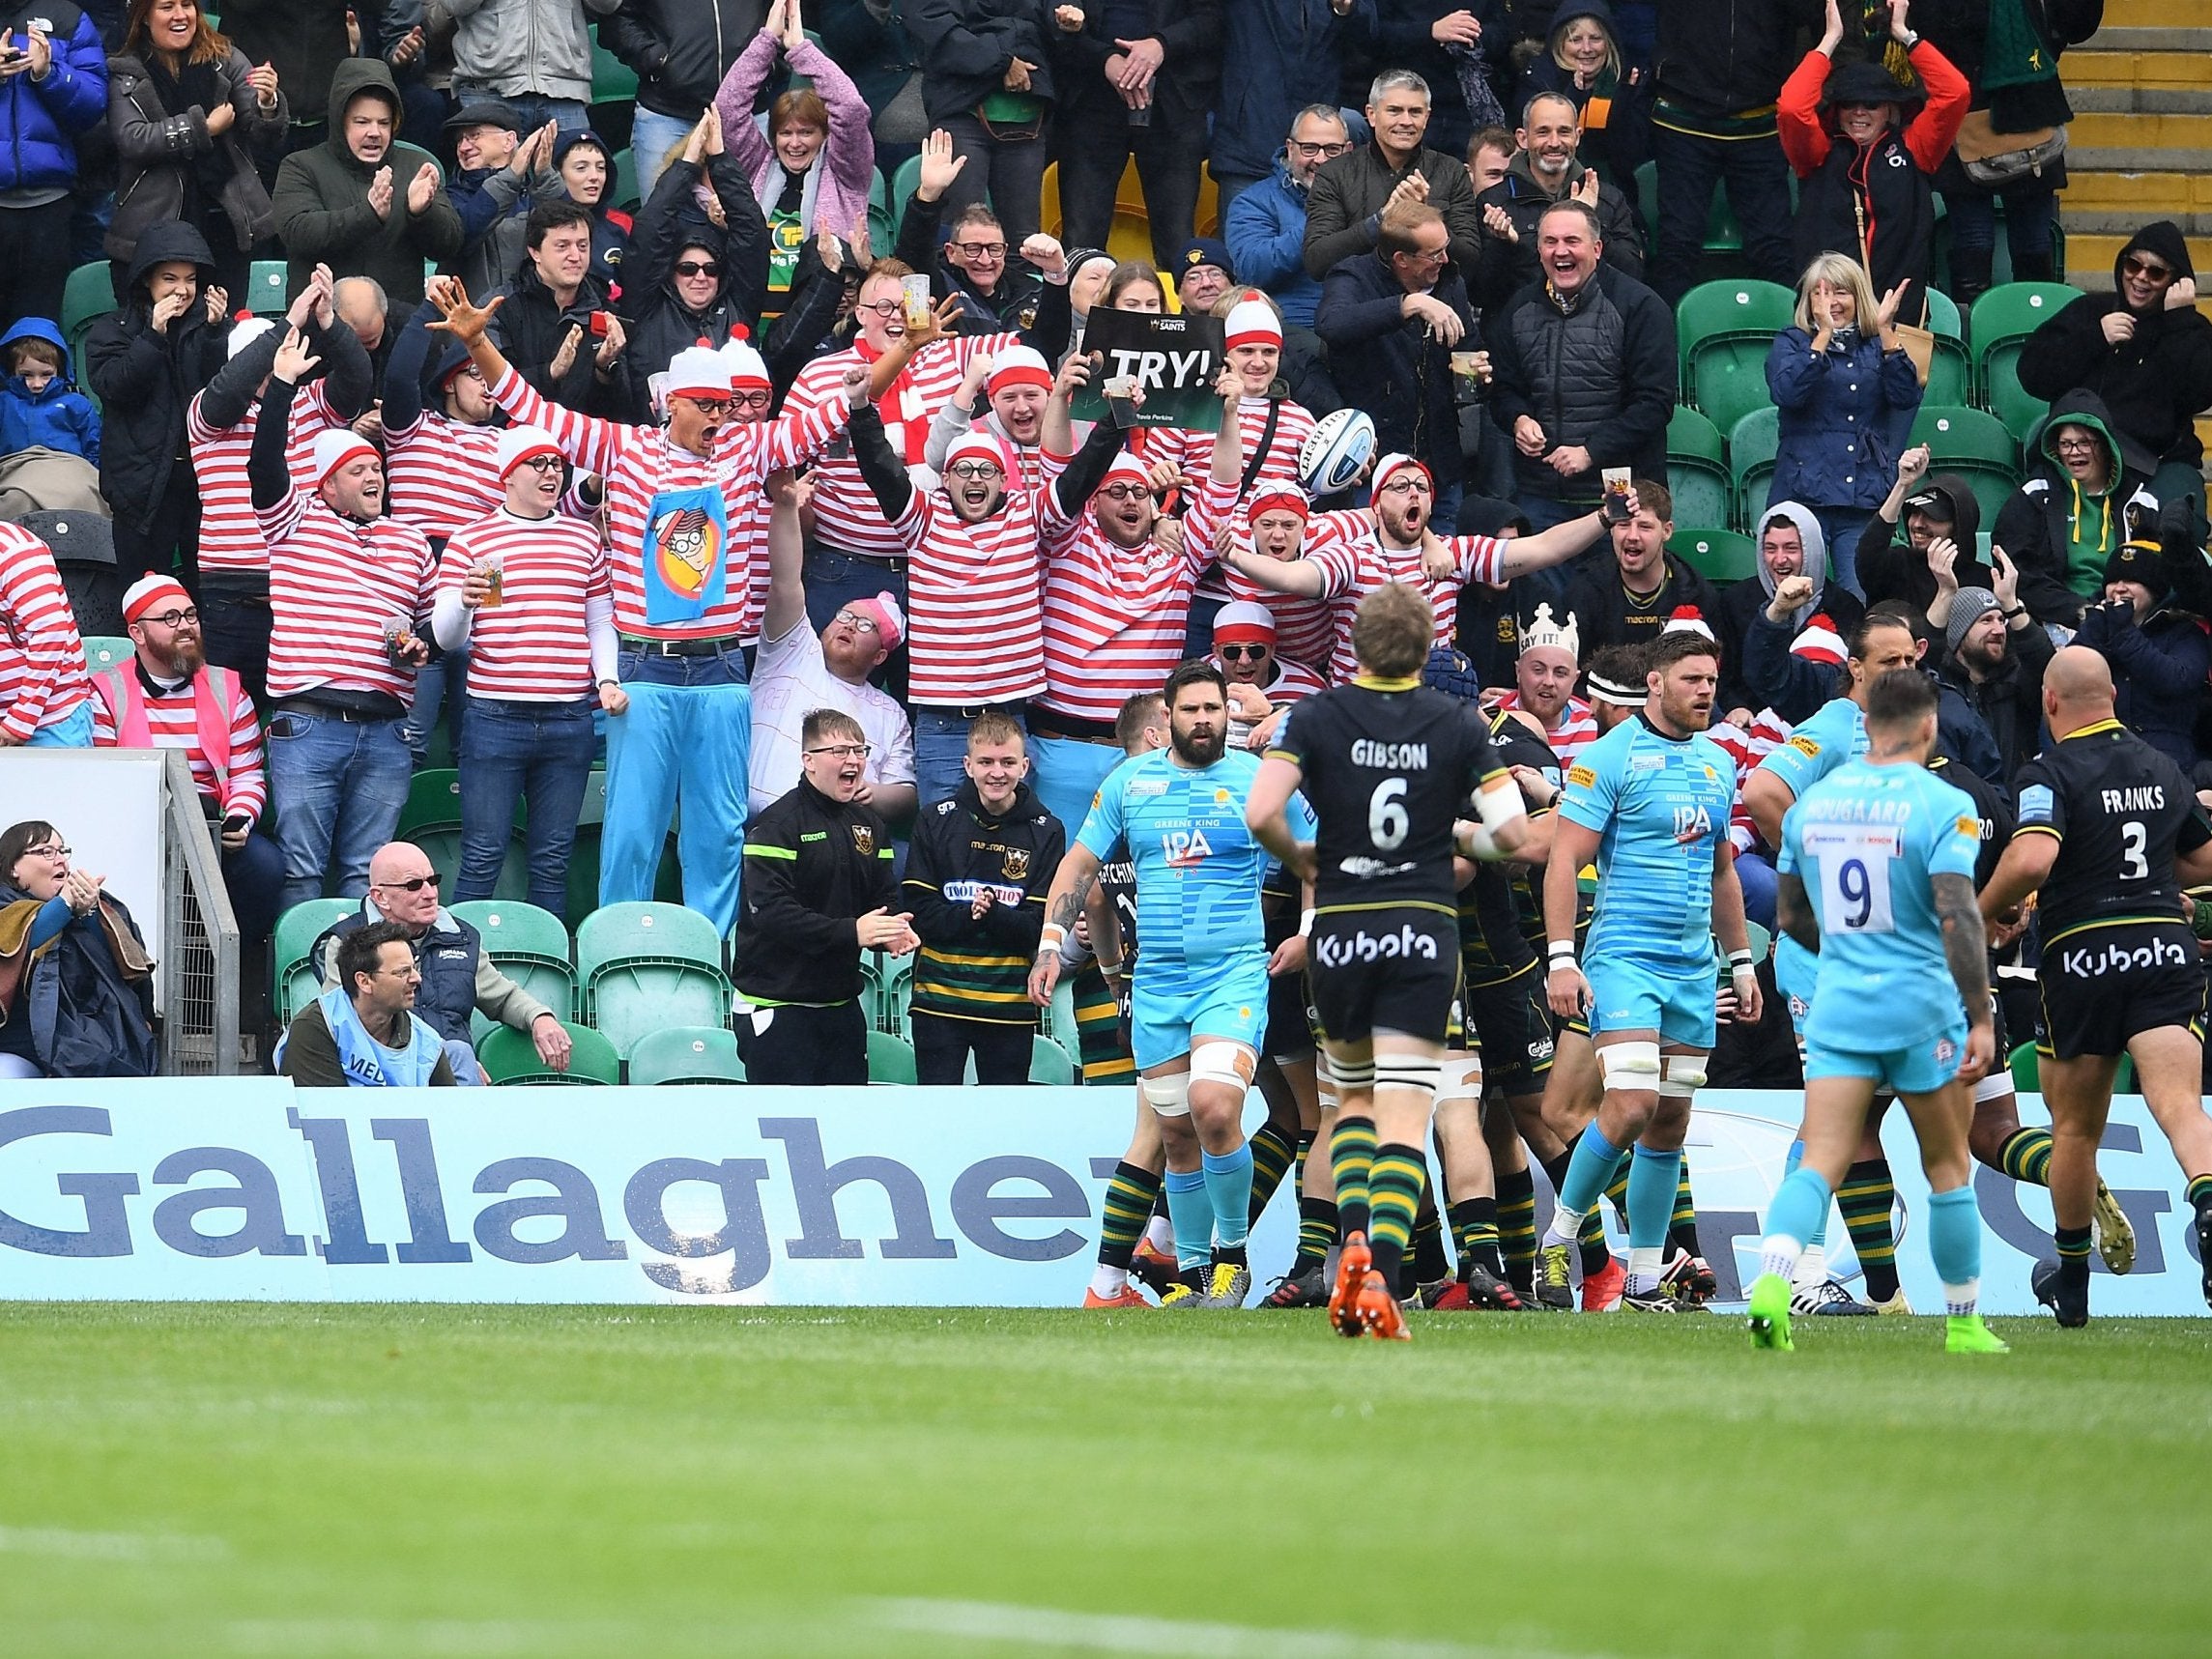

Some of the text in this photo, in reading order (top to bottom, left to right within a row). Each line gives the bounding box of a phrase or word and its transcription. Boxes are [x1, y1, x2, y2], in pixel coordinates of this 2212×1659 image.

[1160, 323, 1186, 331] SAINTS
[1109, 349, 1211, 388] TRY!
[1302, 411, 1347, 473] GILBERT
[1624, 615, 1658, 624] macron
[1520, 633, 1559, 652] SAY IT!
[1350, 737, 1428, 770] GIBSON
[1368, 777, 1410, 851] 6
[1665, 793, 1717, 804] GREENE KING
[2101, 786, 2165, 814] FRANKS
[1154, 819, 1192, 828] GREENE
[1673, 805, 1711, 836] IPA
[1977, 818, 1994, 840] RO
[970, 841, 1005, 853] maron
[1162, 829, 1213, 862] IPA
[2118, 821, 2148, 880] 3
[946, 885, 1022, 903] TOOLTION
[1839, 858, 1872, 928] 9
[1316, 924, 1437, 968] Kubota
[2063, 936, 2186, 978] Kubota
[0, 1104, 1124, 1295] Gallaghe
